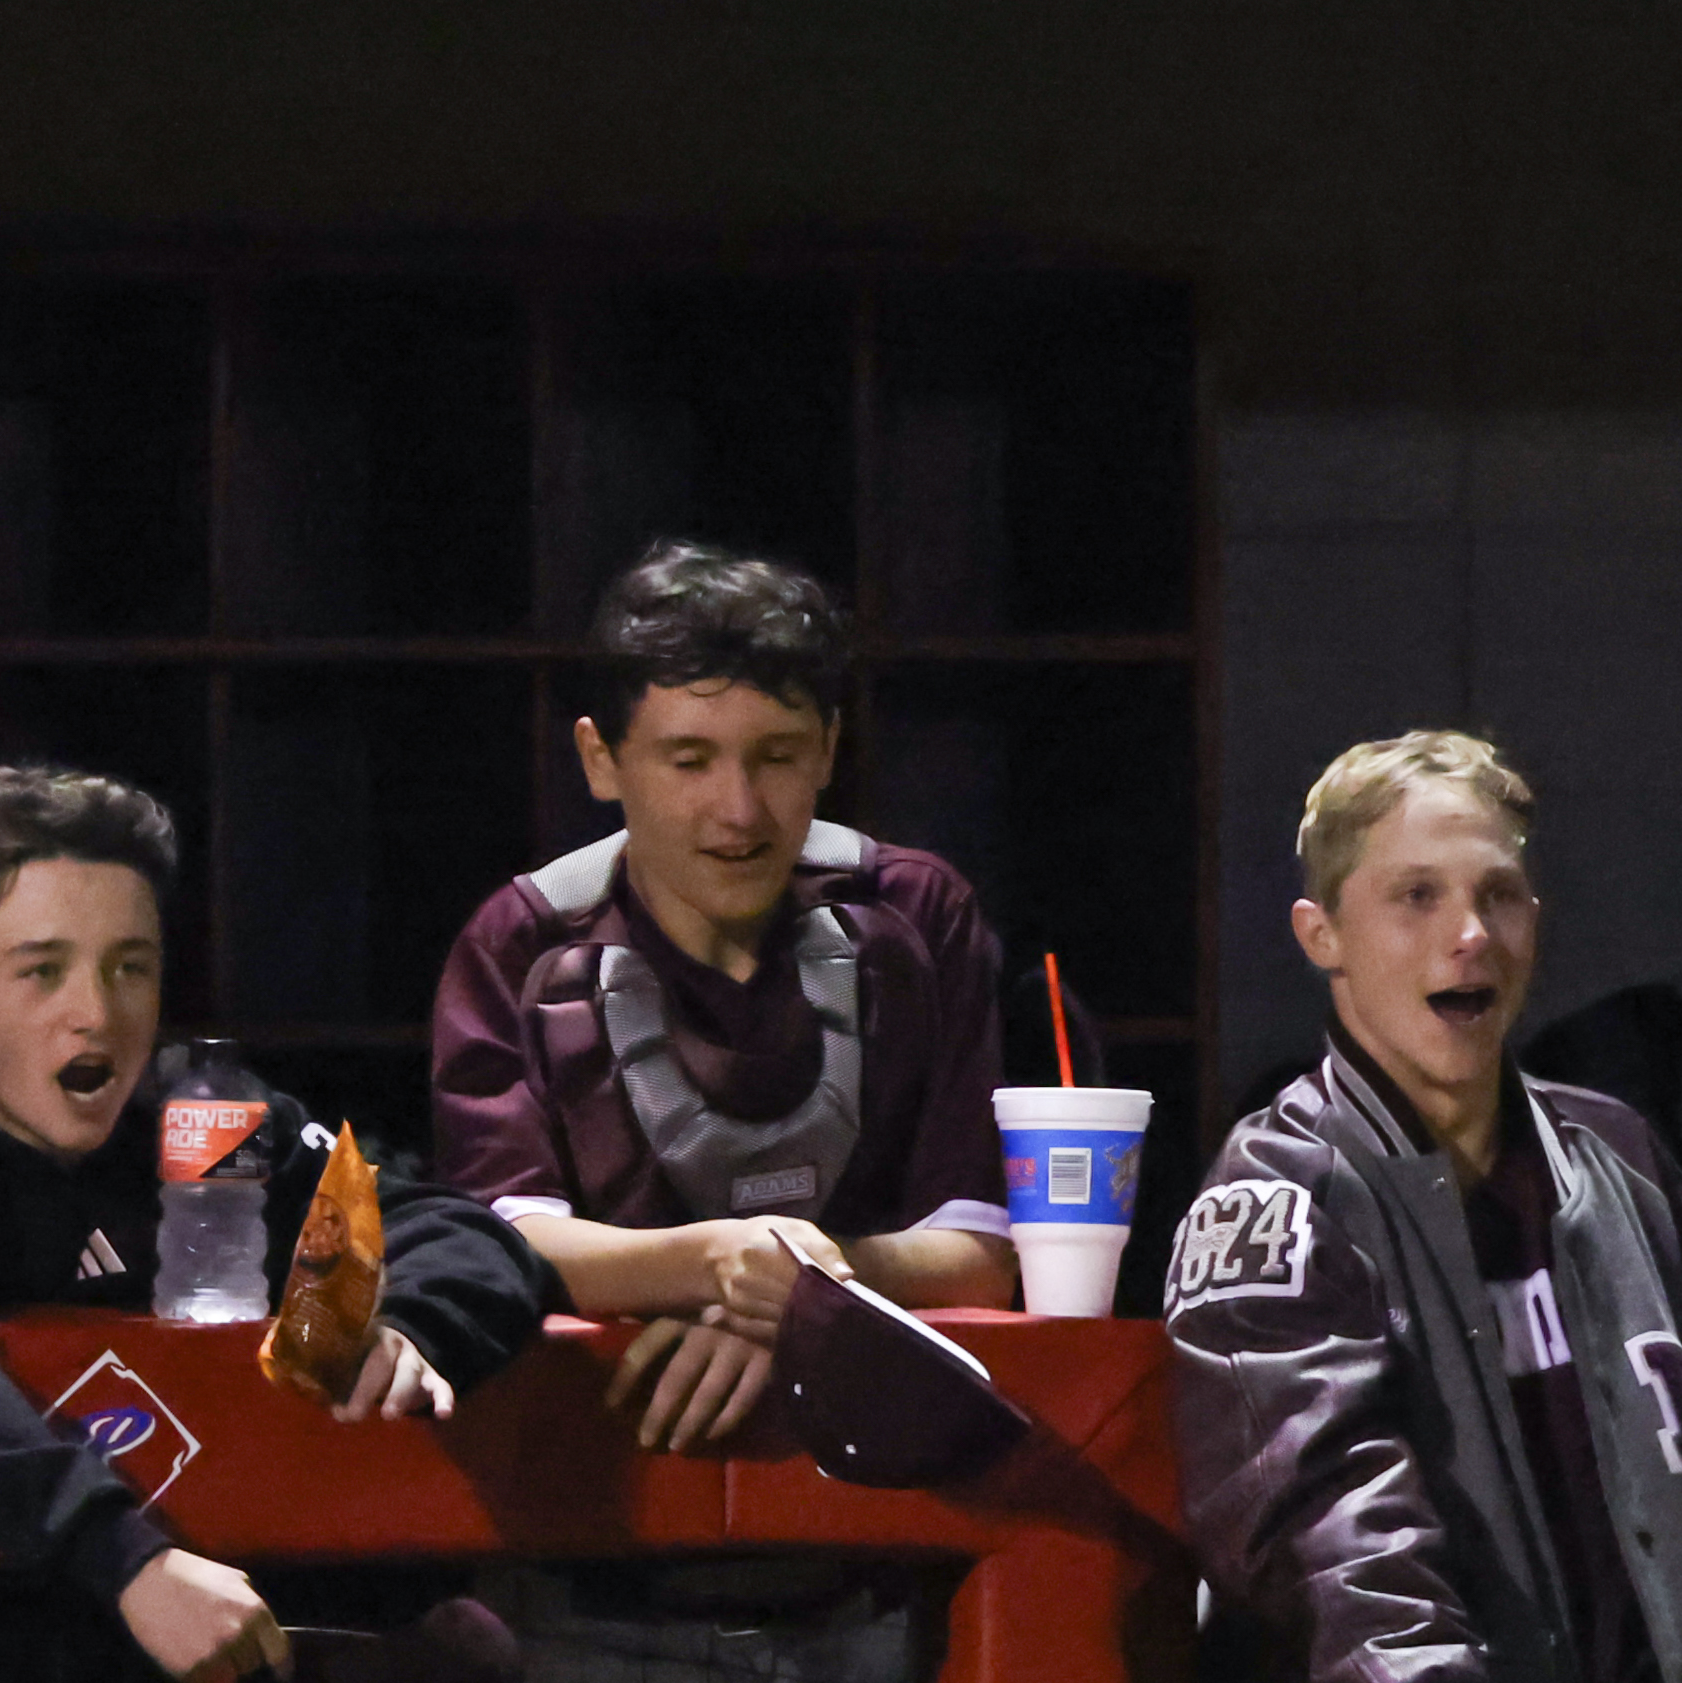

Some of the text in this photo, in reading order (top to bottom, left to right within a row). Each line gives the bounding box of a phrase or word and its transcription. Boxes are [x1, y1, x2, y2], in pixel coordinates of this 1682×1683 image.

[166, 1107, 248, 1129] POWER
[166, 1128, 208, 1149] ADE
[738, 1173, 809, 1204] ADAMS
